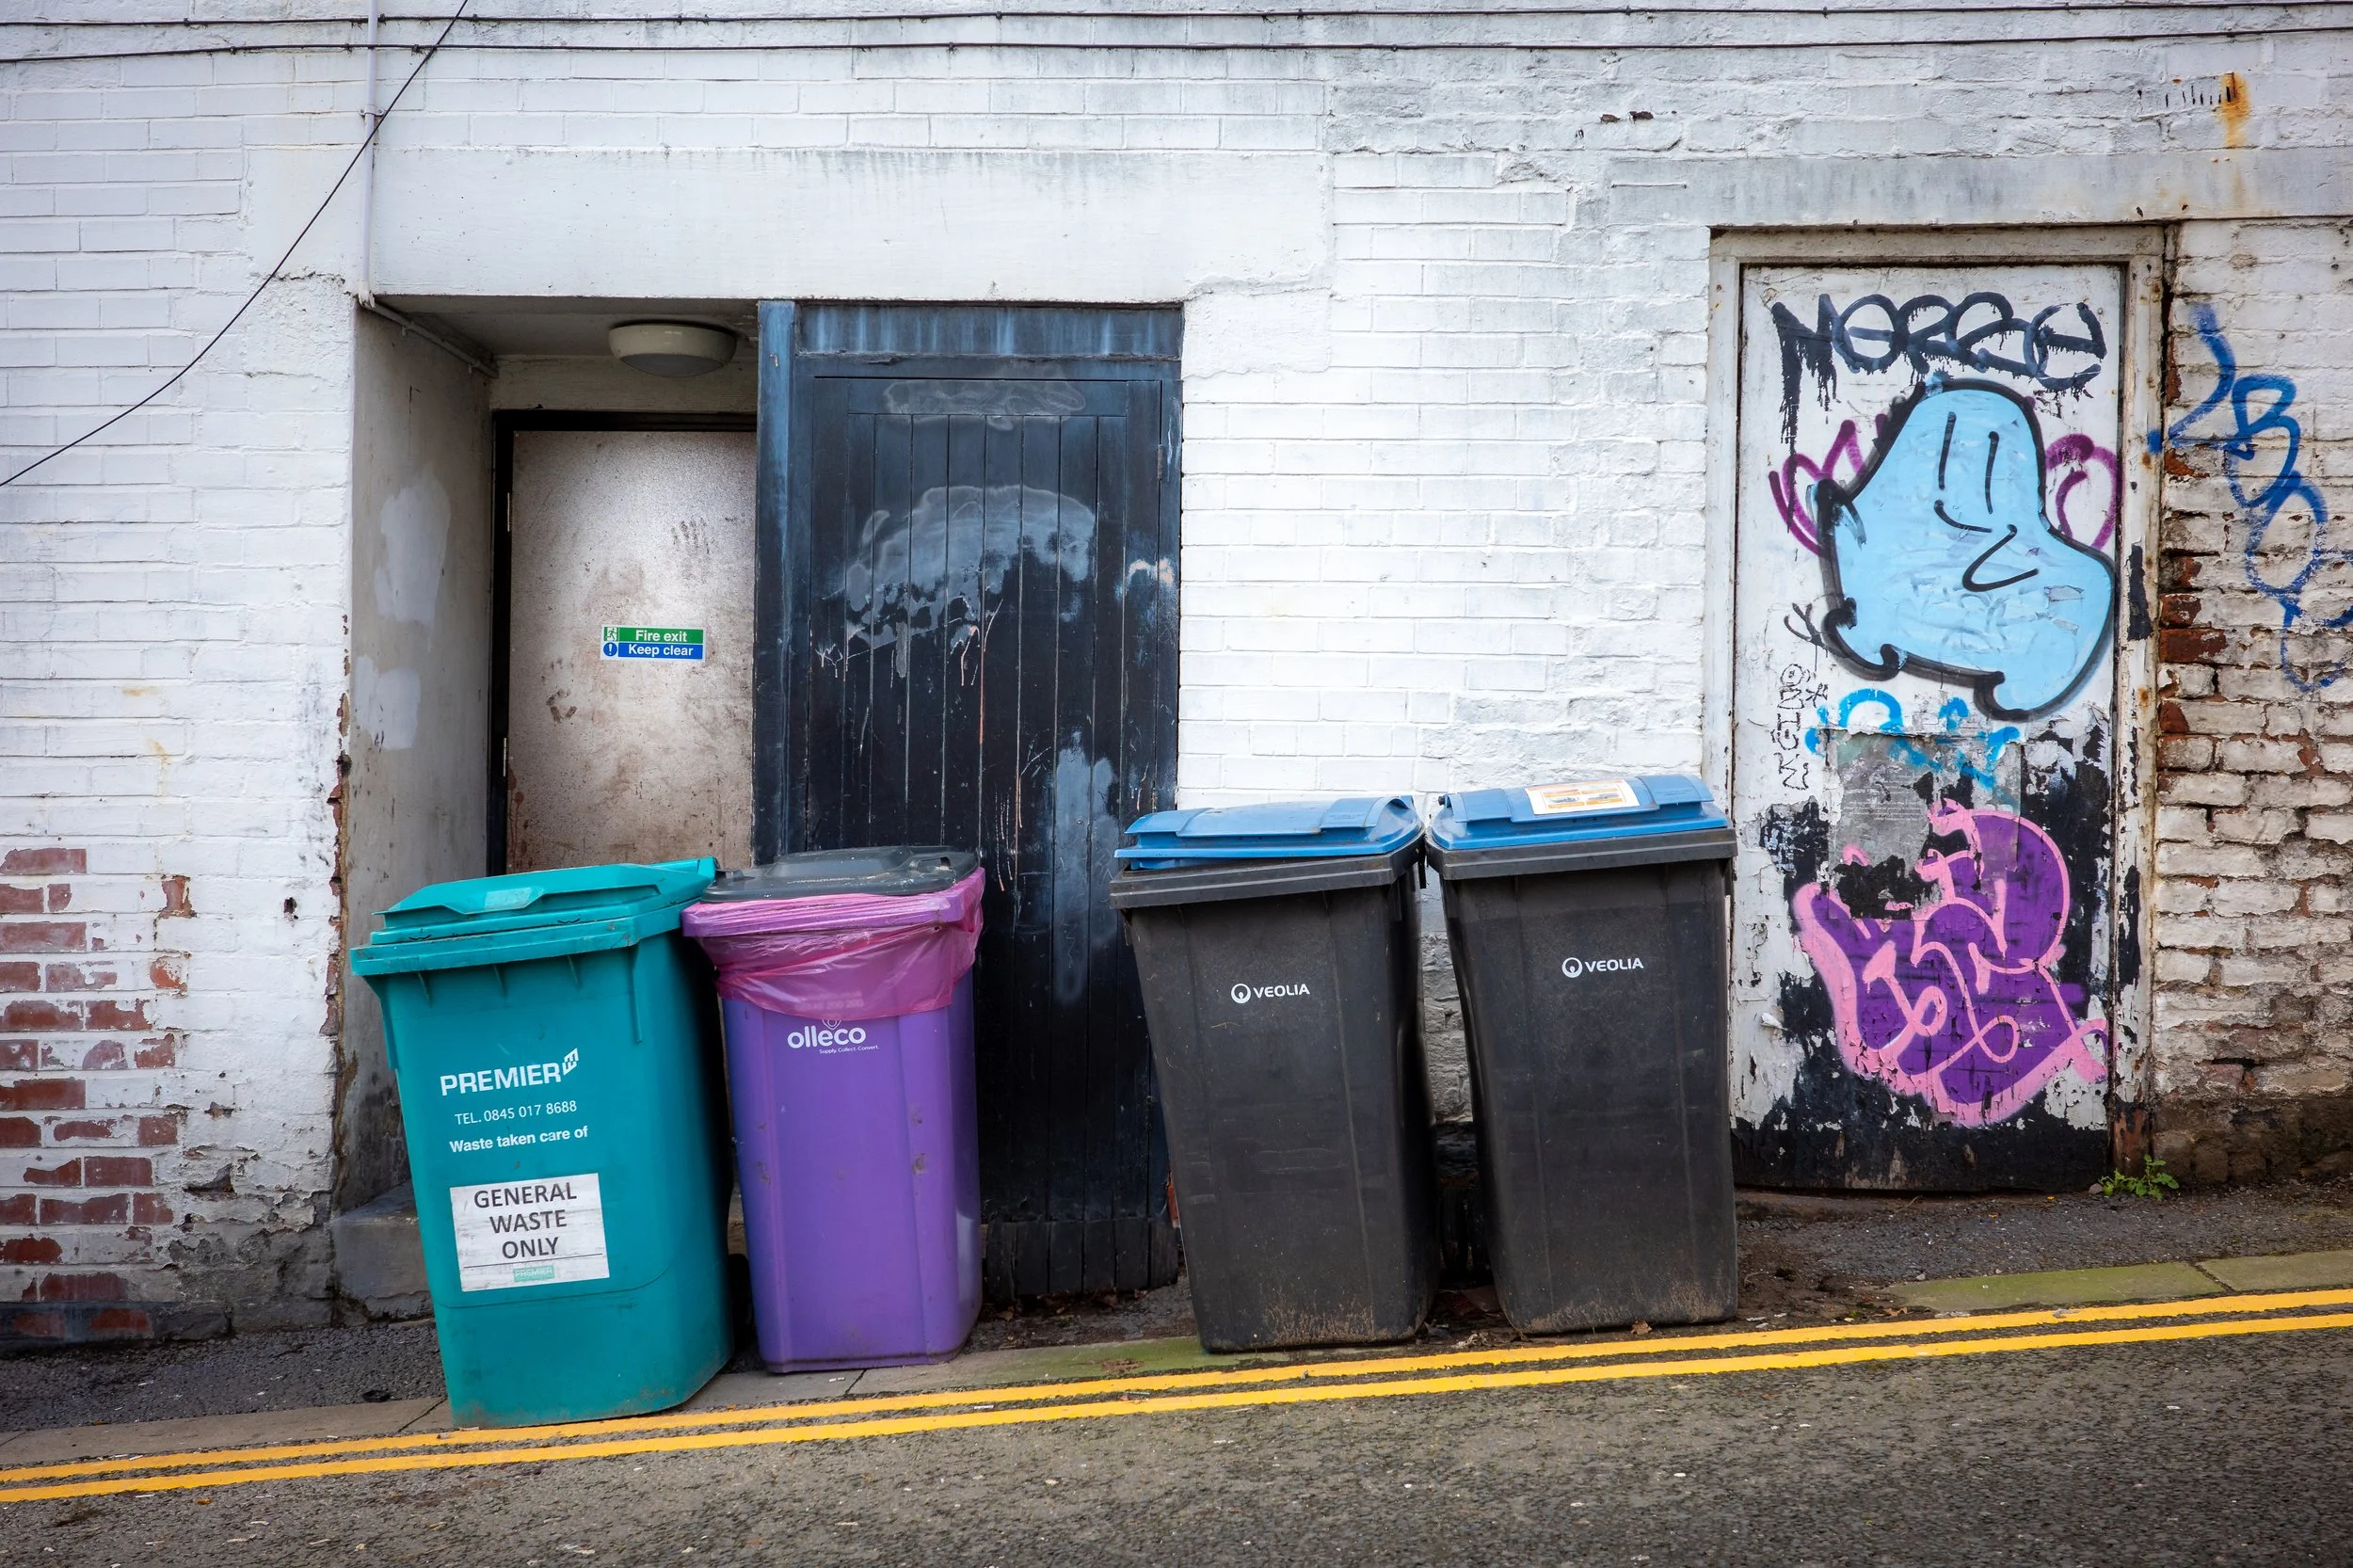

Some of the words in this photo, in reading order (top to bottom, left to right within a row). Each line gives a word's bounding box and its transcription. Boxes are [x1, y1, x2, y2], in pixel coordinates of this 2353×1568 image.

[635, 630, 661, 641] Fire
[664, 631, 687, 642] exit
[628, 643, 660, 657] Keep
[663, 645, 694, 656] clear
[1585, 957, 1644, 972] VEOLIA
[1253, 984, 1310, 999] VEOLIA
[787, 1025, 867, 1049] olleco
[440, 1062, 562, 1096] PREMIER
[455, 1112, 482, 1126] TEL.
[484, 1107, 515, 1122] 0845
[519, 1104, 542, 1118] 017
[546, 1099, 577, 1115] 8688
[449, 1137, 493, 1153] Waste
[497, 1132, 536, 1148] taken
[539, 1128, 571, 1143] care
[573, 1125, 589, 1139] of
[473, 1181, 577, 1209] GENERAL
[489, 1209, 568, 1234] WASTE
[502, 1236, 559, 1259] ONLY
